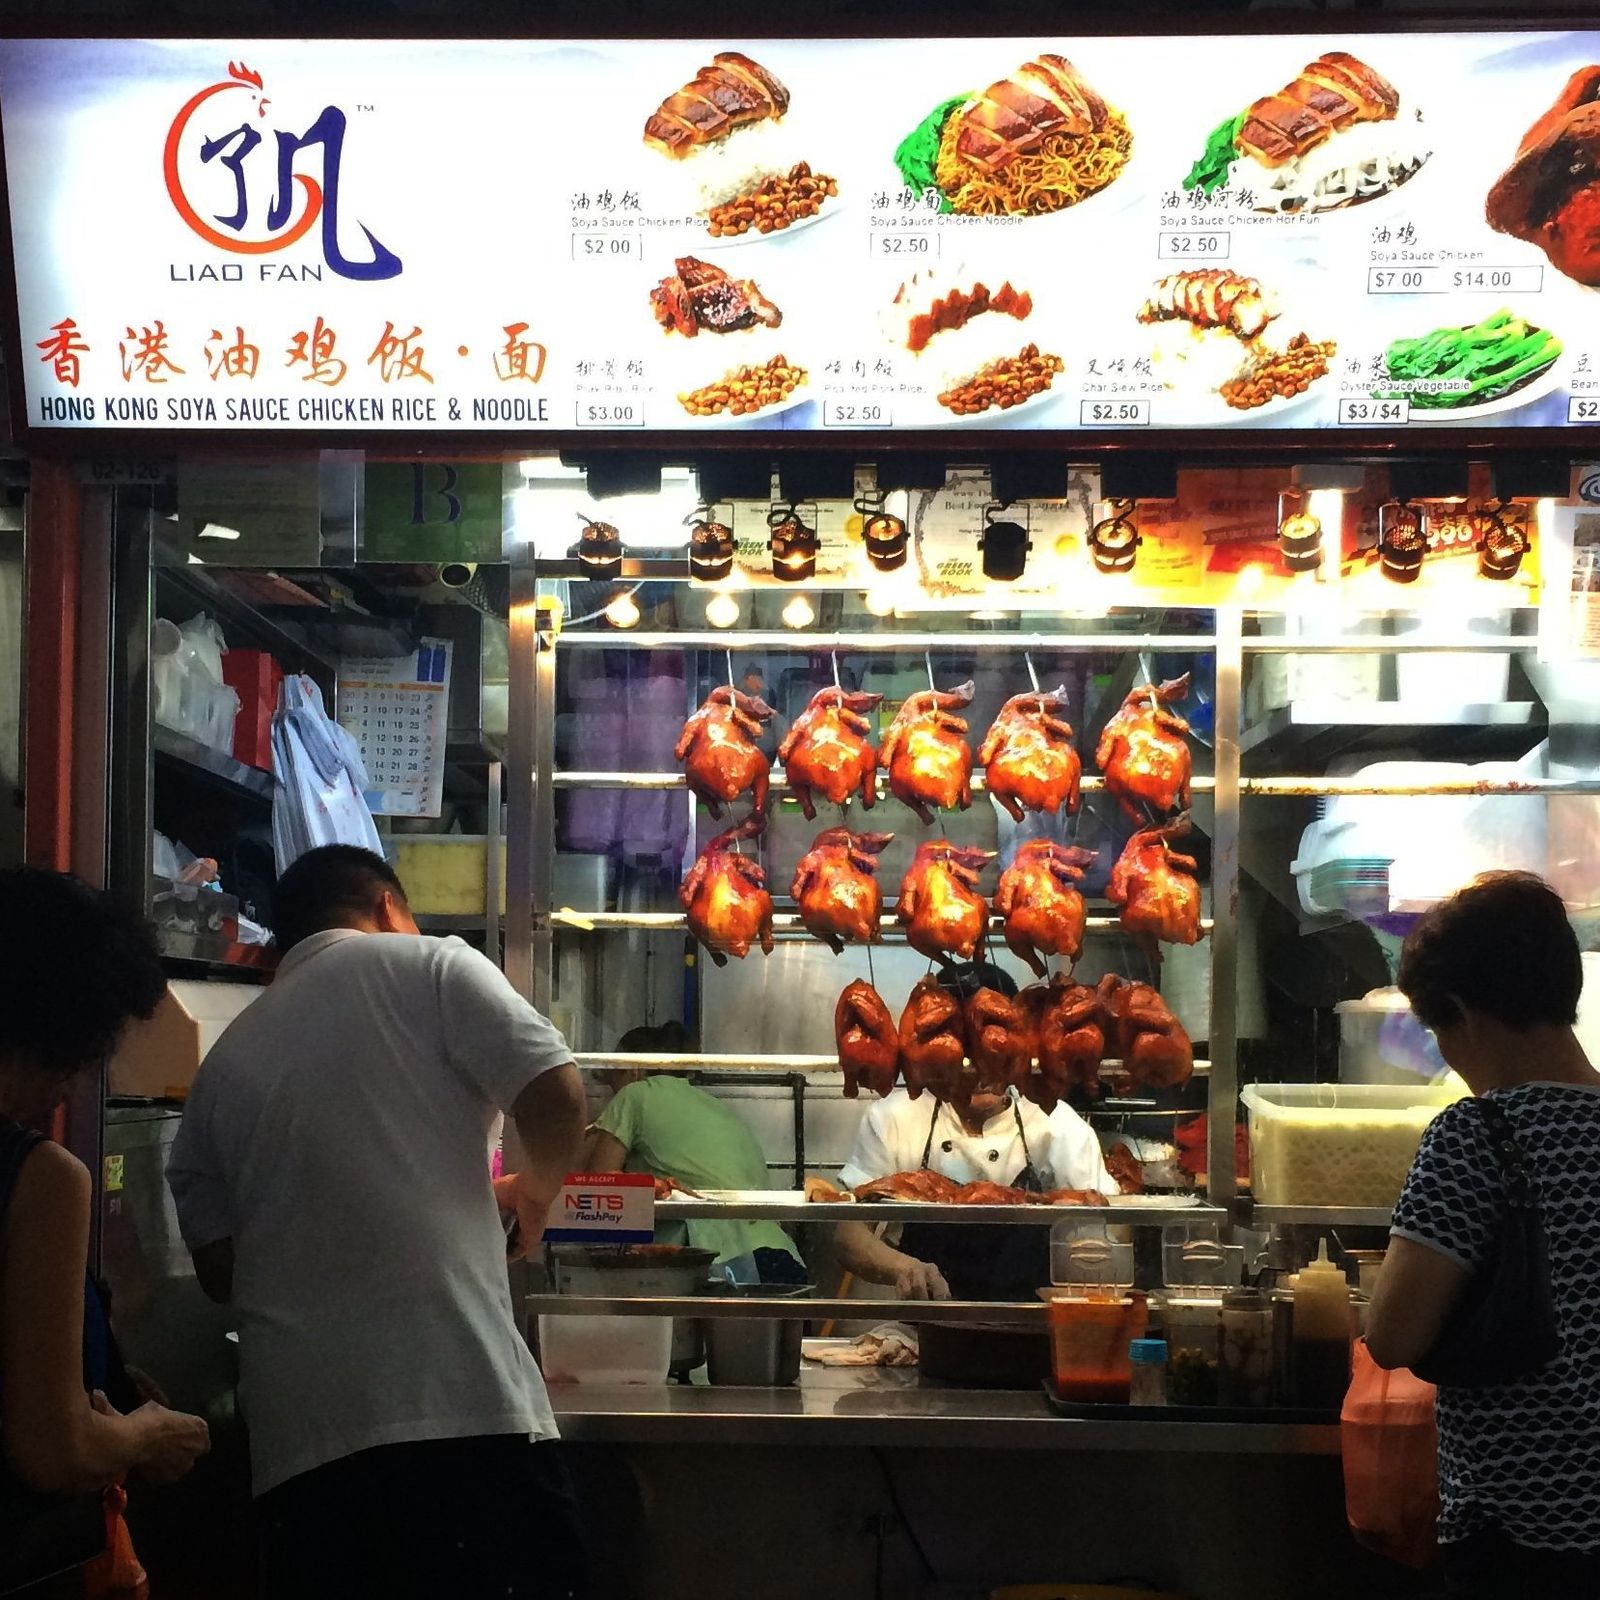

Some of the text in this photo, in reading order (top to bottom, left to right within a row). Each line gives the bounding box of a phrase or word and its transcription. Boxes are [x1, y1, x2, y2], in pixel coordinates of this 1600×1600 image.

[571, 217, 709, 229] Soya Sauce Chicken Rice
[871, 216, 1024, 228] Soya Sauce Chicken Noodle
[1160, 214, 1320, 227] Soya Sauce Chicken Hor Fun
[584, 239, 630, 254] $200
[883, 238, 928, 253] $2.50
[1171, 237, 1217, 253] $2.50
[1371, 250, 1483, 262] Soya Sauce Chicken
[169, 264, 323, 281] LIAO FAN
[1453, 271, 1511, 287] $14.00
[1340, 380, 1470, 392] Oyster Sauce Vegetable
[1571, 379, 1599, 389] Bean
[40, 397, 549, 421] HONG KONG SOYA SAUCE CHICKEN RICE & NOODLE
[588, 406, 633, 420] $3.00
[835, 406, 881, 420] $2.50
[1093, 404, 1139, 420] $2.50
[565, 1194, 624, 1211] NETS
[575, 1211, 624, 1224] FlashPay
